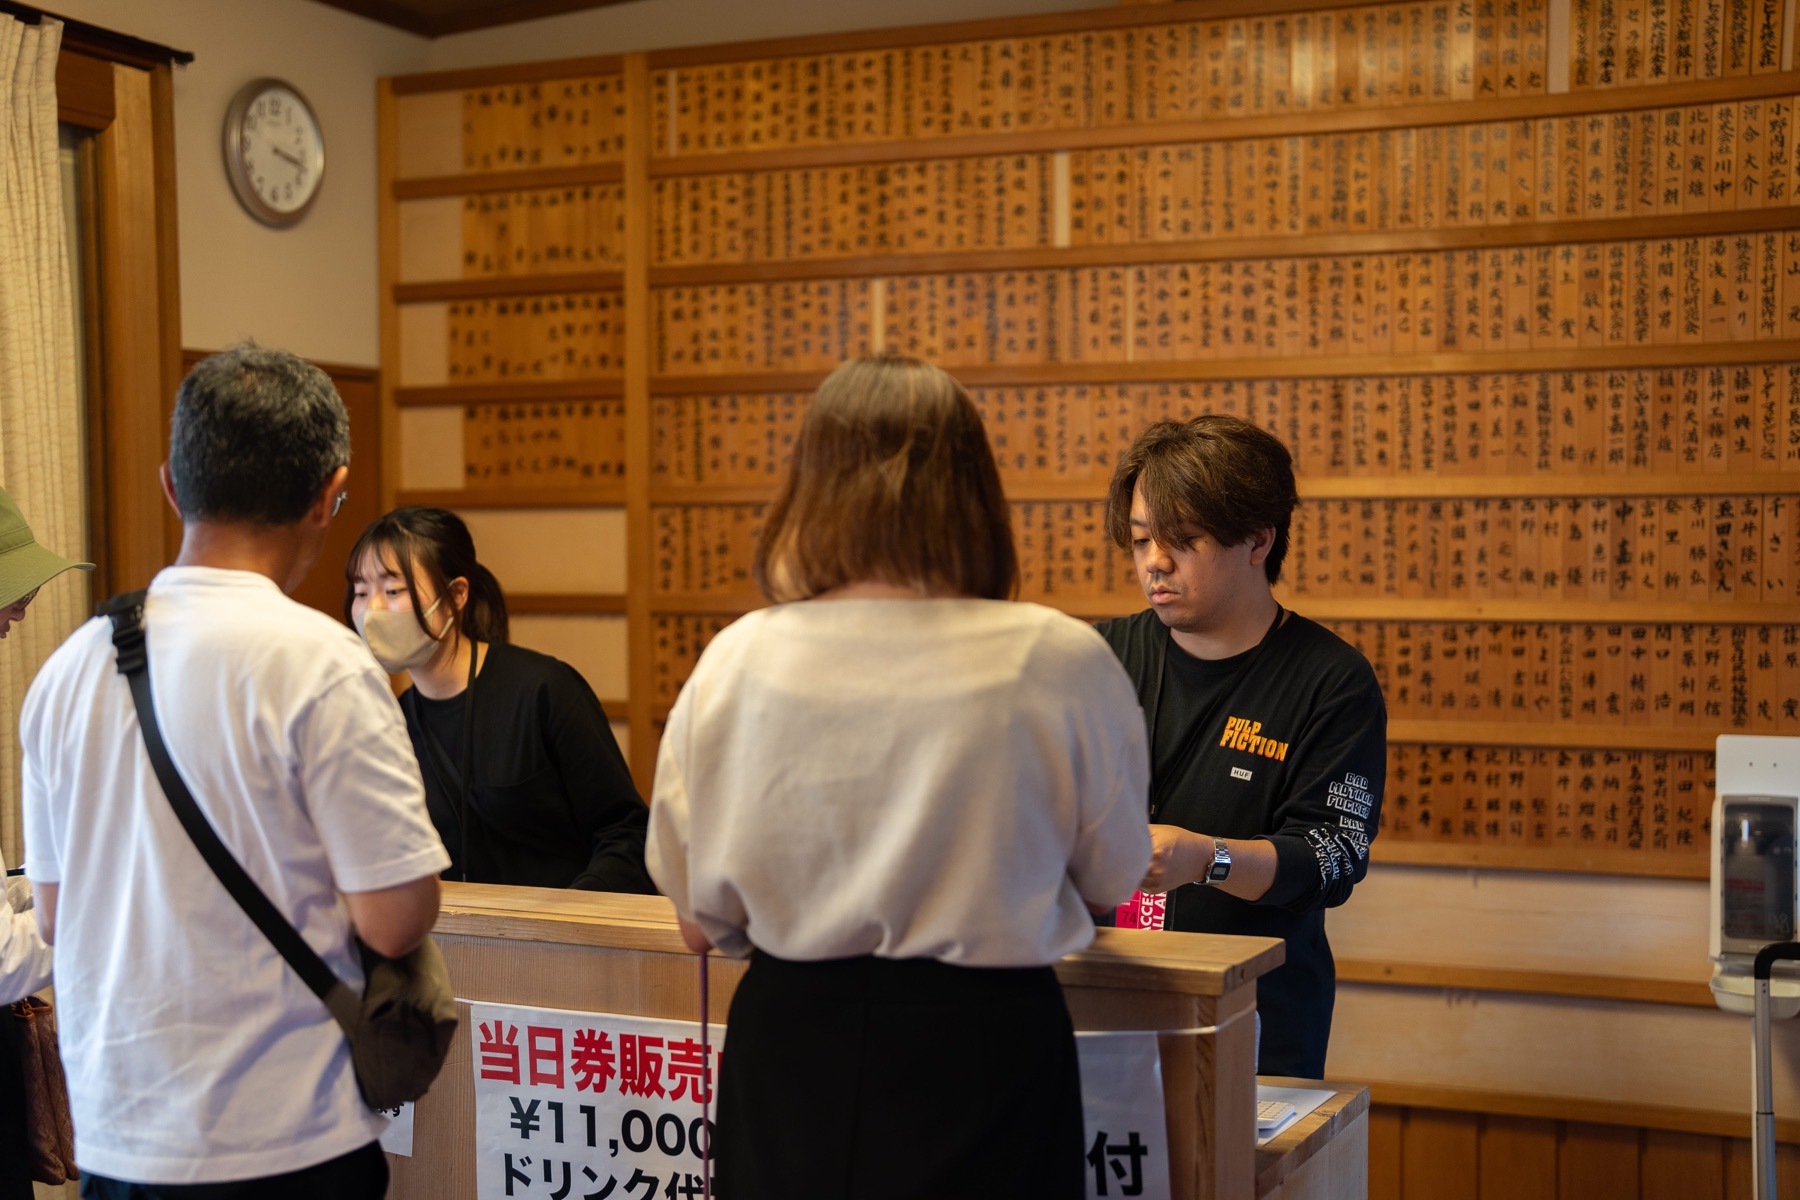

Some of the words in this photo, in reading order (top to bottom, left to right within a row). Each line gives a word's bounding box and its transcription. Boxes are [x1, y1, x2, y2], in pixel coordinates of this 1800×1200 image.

[1713, 106, 1735, 197] 株式会社川中
[1741, 105, 1760, 196] 河合大介
[1734, 236, 1753, 327] 株式会社もり
[1225, 715, 1262, 736] PULP
[1219, 730, 1289, 762] FICTION
[1233, 768, 1250, 779] HUF
[1345, 772, 1368, 790] BAD
[1326, 794, 1371, 819] FUCKER
[1328, 781, 1374, 806] MOTHER
[1121, 910, 1138, 925] 74
[479, 1020, 722, 1104] 当日券販売
[1086, 1130, 1148, 1197] 付
